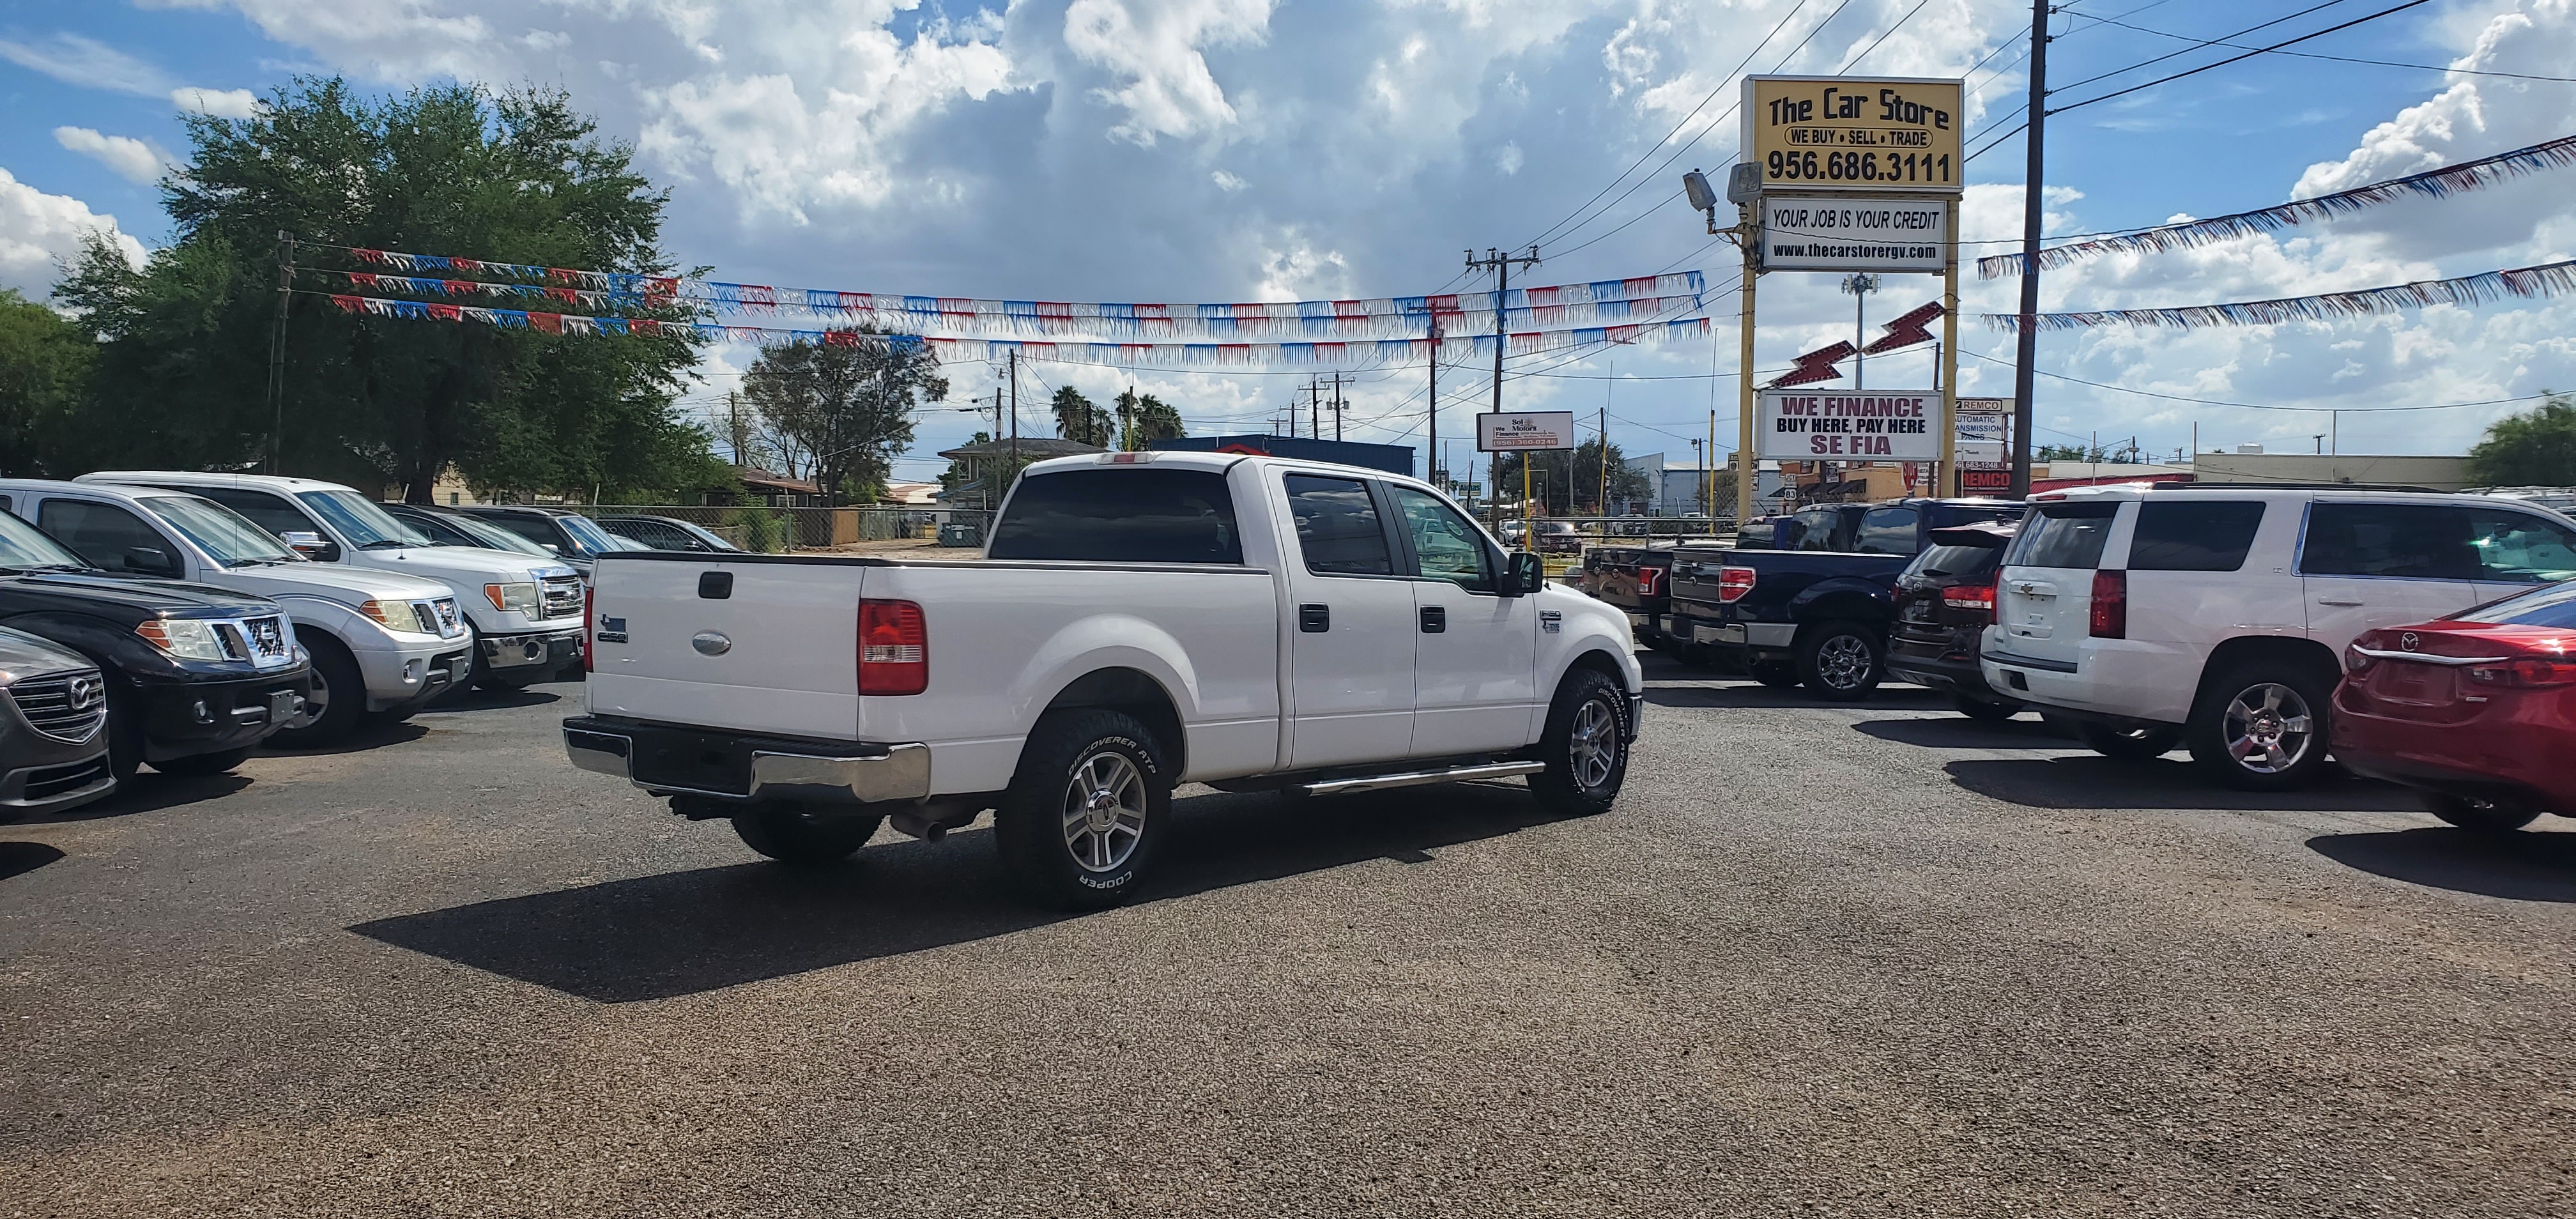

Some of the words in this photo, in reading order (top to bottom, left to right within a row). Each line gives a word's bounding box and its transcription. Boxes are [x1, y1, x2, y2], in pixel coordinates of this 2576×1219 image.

[1769, 96, 1812, 126] The
[1823, 88, 1868, 119] Car
[1880, 89, 1949, 130] Store
[1791, 129, 1810, 144] WE
[1813, 130, 1836, 144] BUY
[1849, 130, 1876, 145] SELL
[1890, 131, 1928, 146] TRADE
[1768, 150, 1949, 181] 956.686.3111
[1774, 209, 1808, 227] YOUR
[1811, 210, 1837, 227] JOB
[1839, 210, 1851, 228] IS
[1855, 210, 1890, 229] YOUR
[1893, 211, 1940, 230] CREDIT
[1774, 243, 1936, 259] www.thecarstorergv.com
[1781, 397, 1818, 417] WE
[1825, 397, 1923, 417] FINANCE
[1964, 401, 1998, 410] REMCO
[1777, 418, 1806, 434] BUY
[1811, 418, 1852, 435] HERE,
[1856, 419, 1883, 434] PAY
[1888, 419, 1926, 434] HERE
[1811, 434, 1842, 454] SE
[1850, 436, 1892, 455] FIA
[1904, 461, 1917, 477] STOP
[1068, 735, 1137, 777] DISCOVERER
[1138, 749, 1156, 774] ATP
[1079, 870, 1133, 889] COOPER
